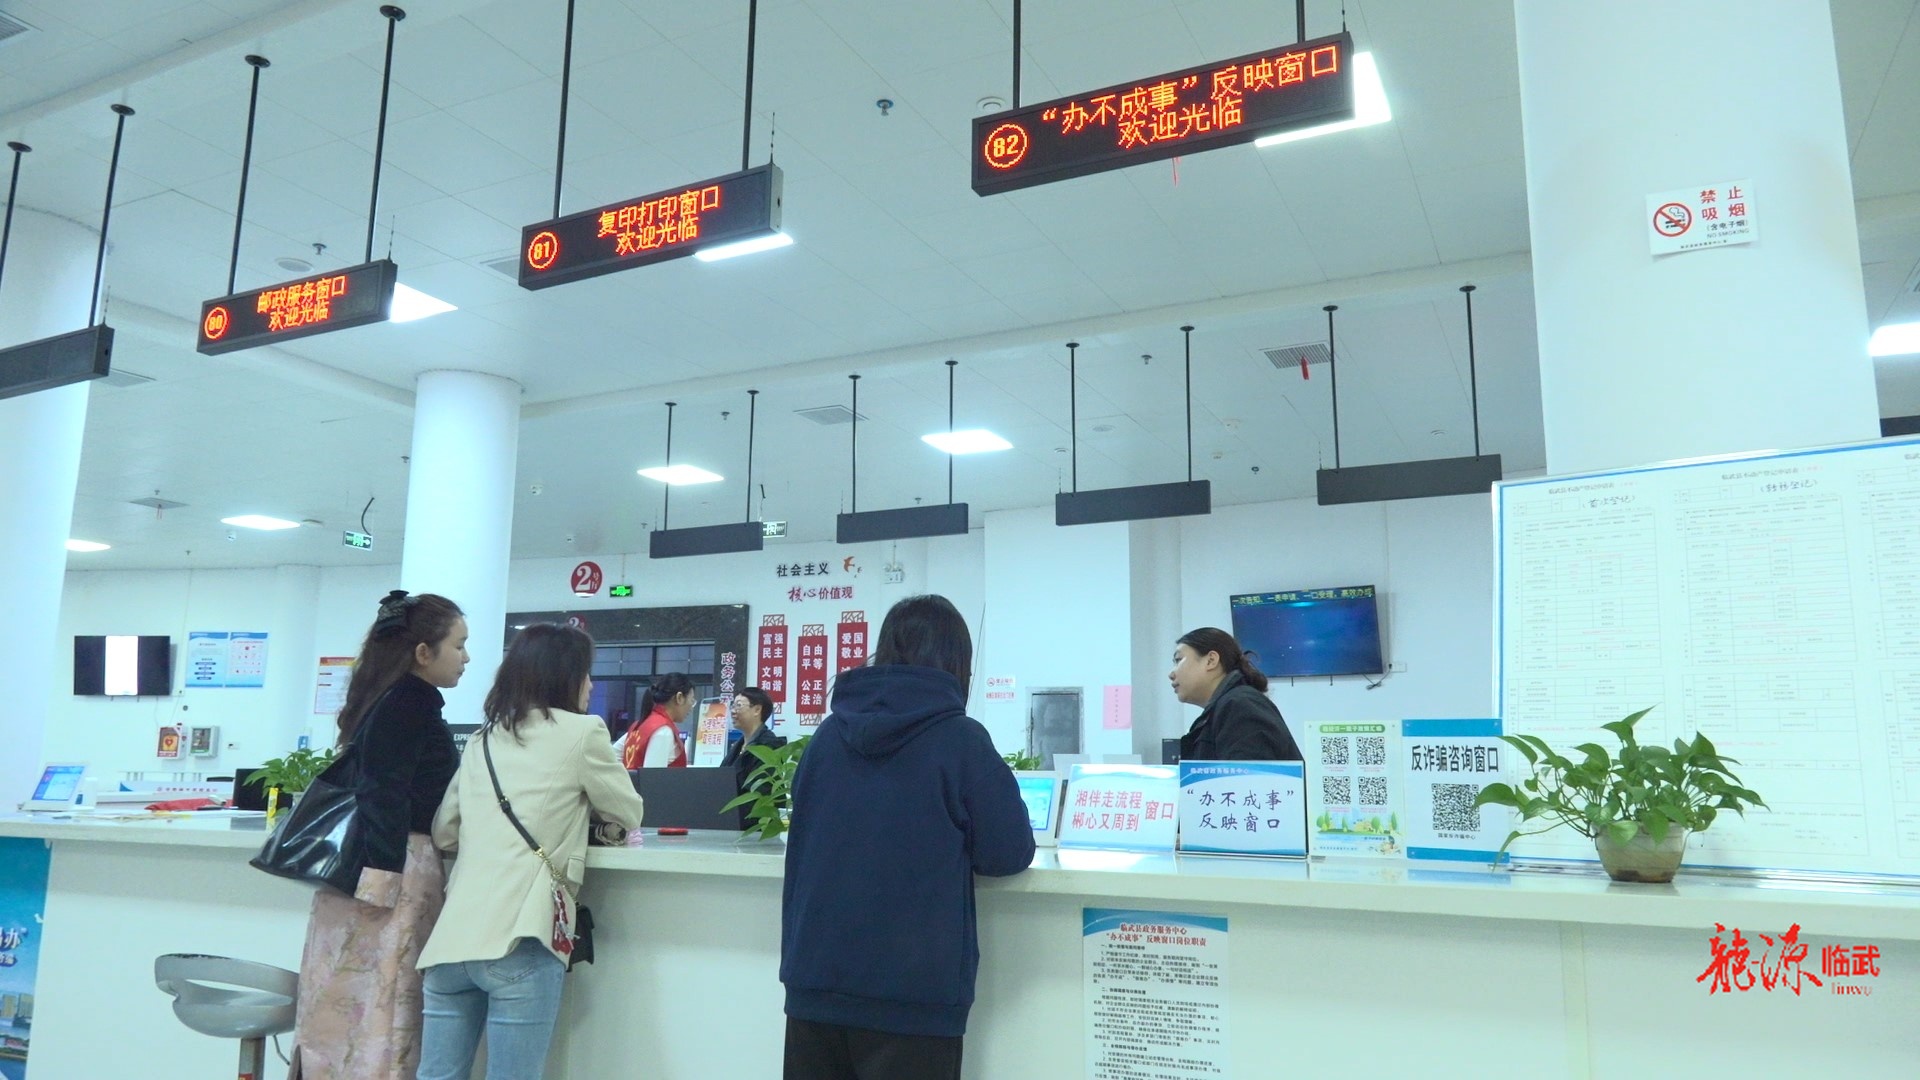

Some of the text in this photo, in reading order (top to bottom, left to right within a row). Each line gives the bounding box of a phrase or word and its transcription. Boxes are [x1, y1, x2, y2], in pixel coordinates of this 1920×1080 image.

[1042, 45, 1337, 135] “办不成事”反映窗口
[1117, 97, 1243, 150] 欢迎光临
[993, 134, 1019, 158] 82
[1699, 186, 1744, 204] 禁止
[597, 185, 720, 238] 复印打印窗口
[1701, 202, 1746, 221] 吸烟
[615, 215, 699, 256] 欢迎光临
[533, 241, 551, 260] 81
[257, 275, 346, 313] 邮政服务窗口
[208, 316, 224, 330] 80
[268, 301, 330, 331] 欢迎光临
[575, 565, 592, 591] 2
[776, 562, 829, 577] 社会主义
[788, 586, 853, 602] 核心价值观
[1411, 744, 1499, 773] 反诈骗咨询窗口
[1075, 790, 1144, 809] 湘伴走流程
[1145, 800, 1175, 820] 窗口
[1187, 789, 1294, 811] “办不成事”
[1071, 812, 1140, 832] 郴心又周到
[1199, 812, 1281, 833] 反映窗口
[1120, 923, 1188, 935] 临武县政务服务中心
